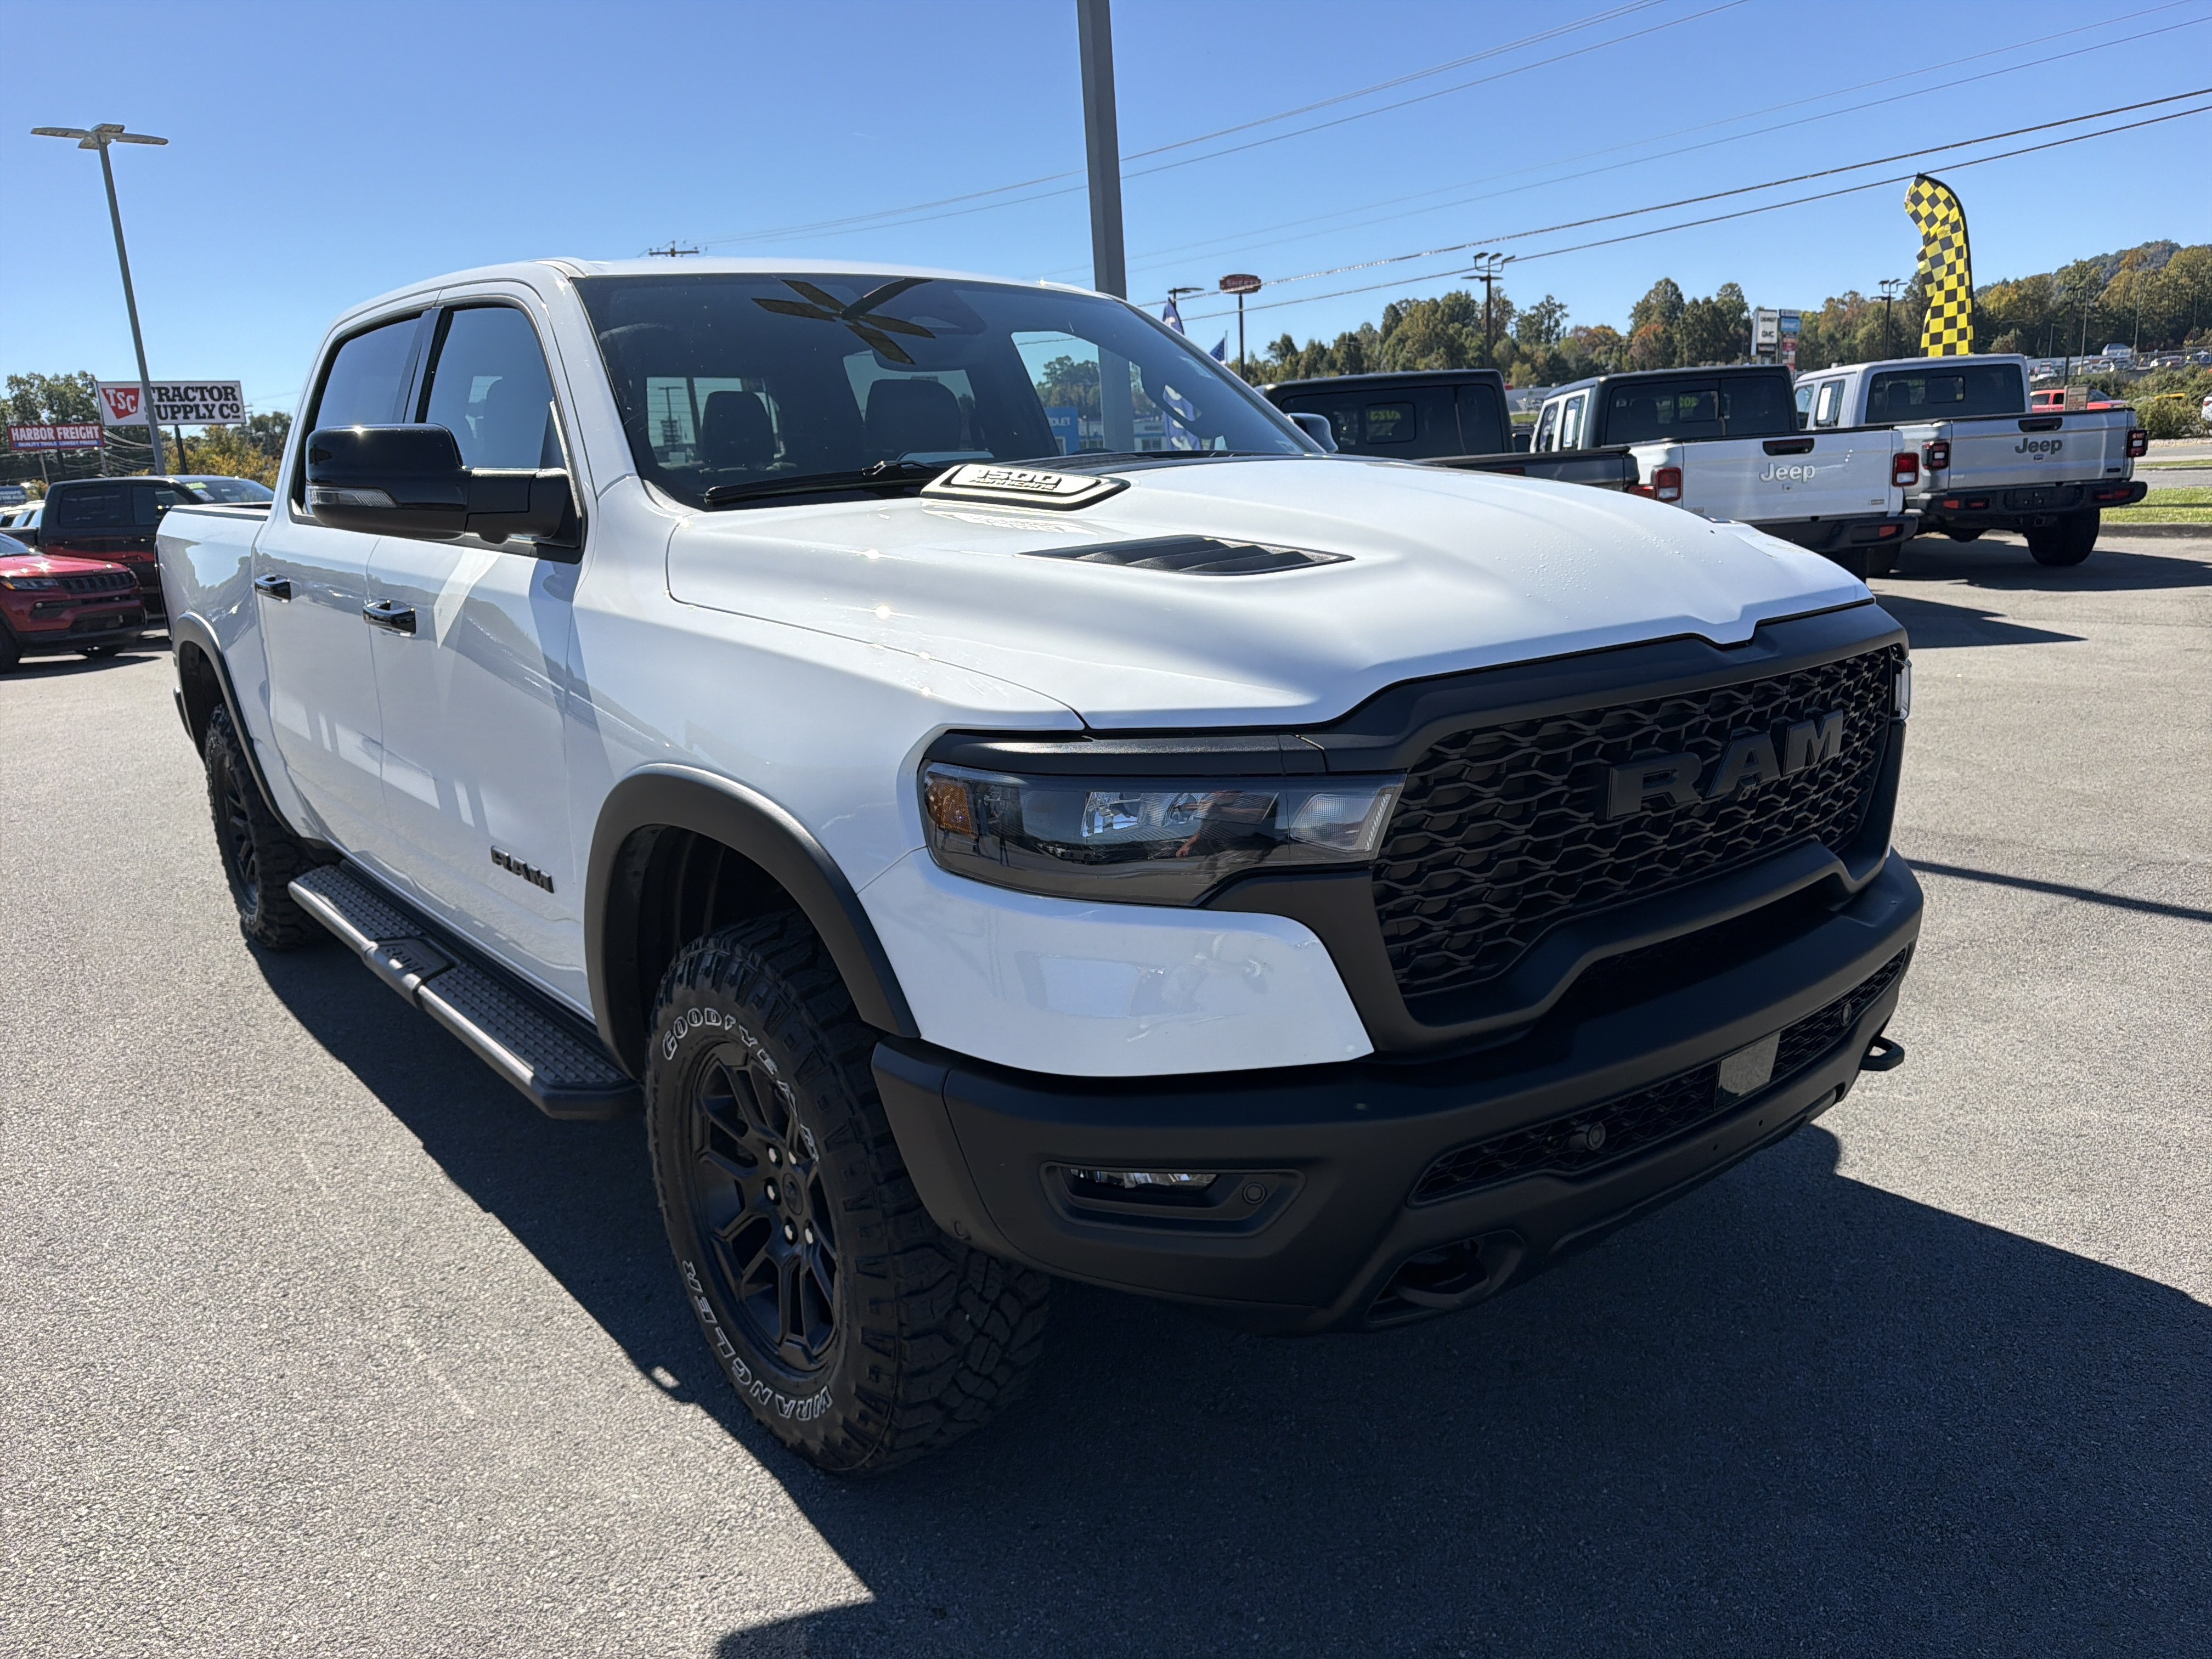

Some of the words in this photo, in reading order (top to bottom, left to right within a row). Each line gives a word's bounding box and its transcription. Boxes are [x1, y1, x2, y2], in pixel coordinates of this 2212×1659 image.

[106, 389, 137, 413] TSC
[145, 404, 215, 420] UPPLY
[11, 427, 54, 441] HARBOR
[56, 426, 99, 439] FREIGHT
[2015, 438, 2063, 455] Jeep
[977, 469, 1063, 486] 1500
[1759, 462, 1816, 483] Jeep
[1607, 709, 1843, 821] RAM
[490, 845, 555, 894] RAM
[682, 1260, 833, 1421] WRANGLER
